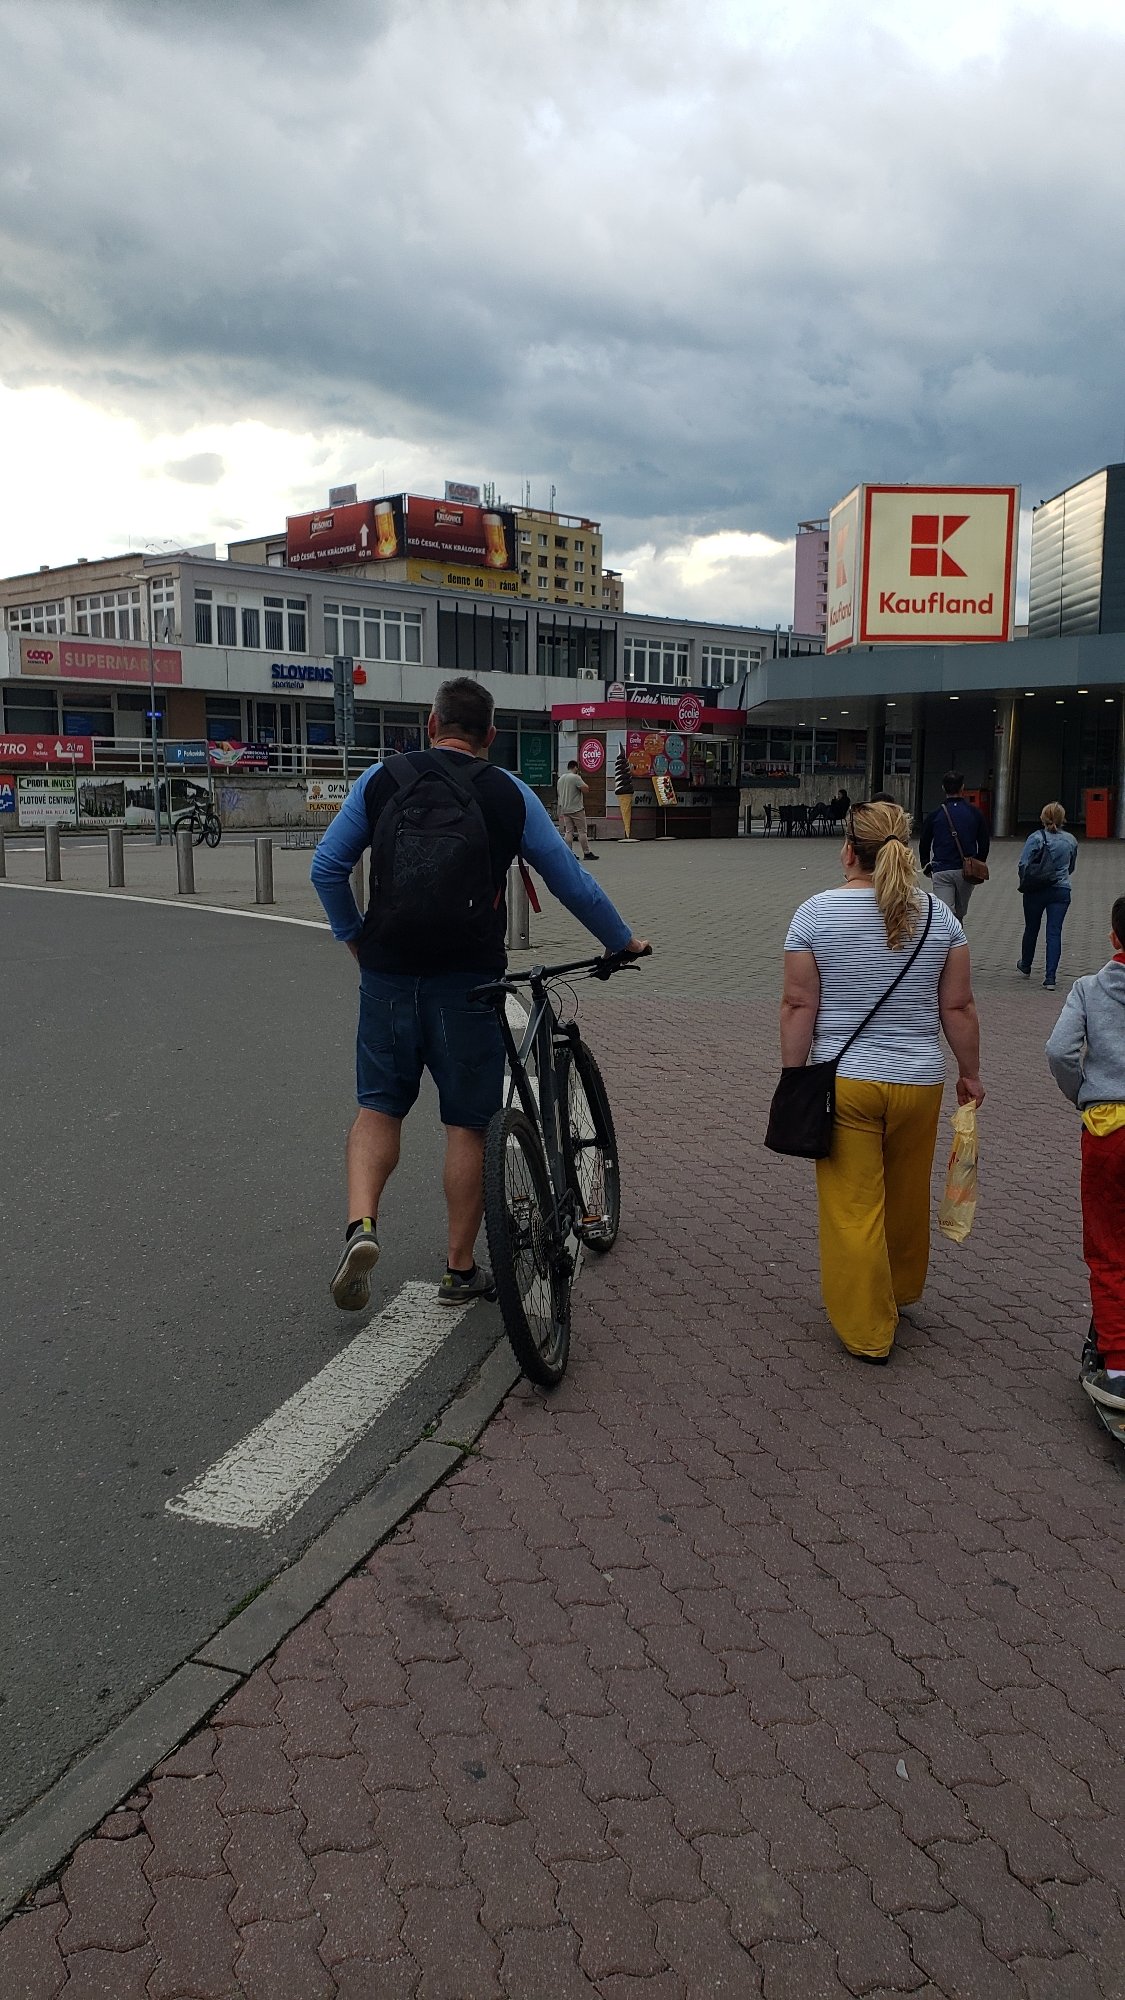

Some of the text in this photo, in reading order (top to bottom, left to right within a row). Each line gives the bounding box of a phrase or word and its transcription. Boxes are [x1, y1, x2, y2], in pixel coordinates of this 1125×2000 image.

[421, 539, 441, 550] ČESKÉ,
[301, 550, 317, 561] ČESKÉ,
[317, 550, 327, 558] TAK
[359, 550, 366, 558] 40
[447, 573, 471, 586] denne
[474, 577, 484, 588] do
[500, 580, 519, 592] rána!
[879, 592, 994, 614] Kaufland
[830, 596, 852, 626] Kaufland
[27, 649, 177, 674] coop SUPERMARKET
[271, 663, 334, 682] SLOVENS
[661, 695, 682, 705] Vietna
[678, 708, 700, 720] Goolie
[177, 749, 182, 758] P
[582, 751, 601, 760] Goolie
[26, 779, 74, 788] PROFIL INVEST
[0, 784, 12, 796] A
[20, 793, 75, 805] PLOTOVÉ CENTRUM
[635, 792, 653, 804] gofry
